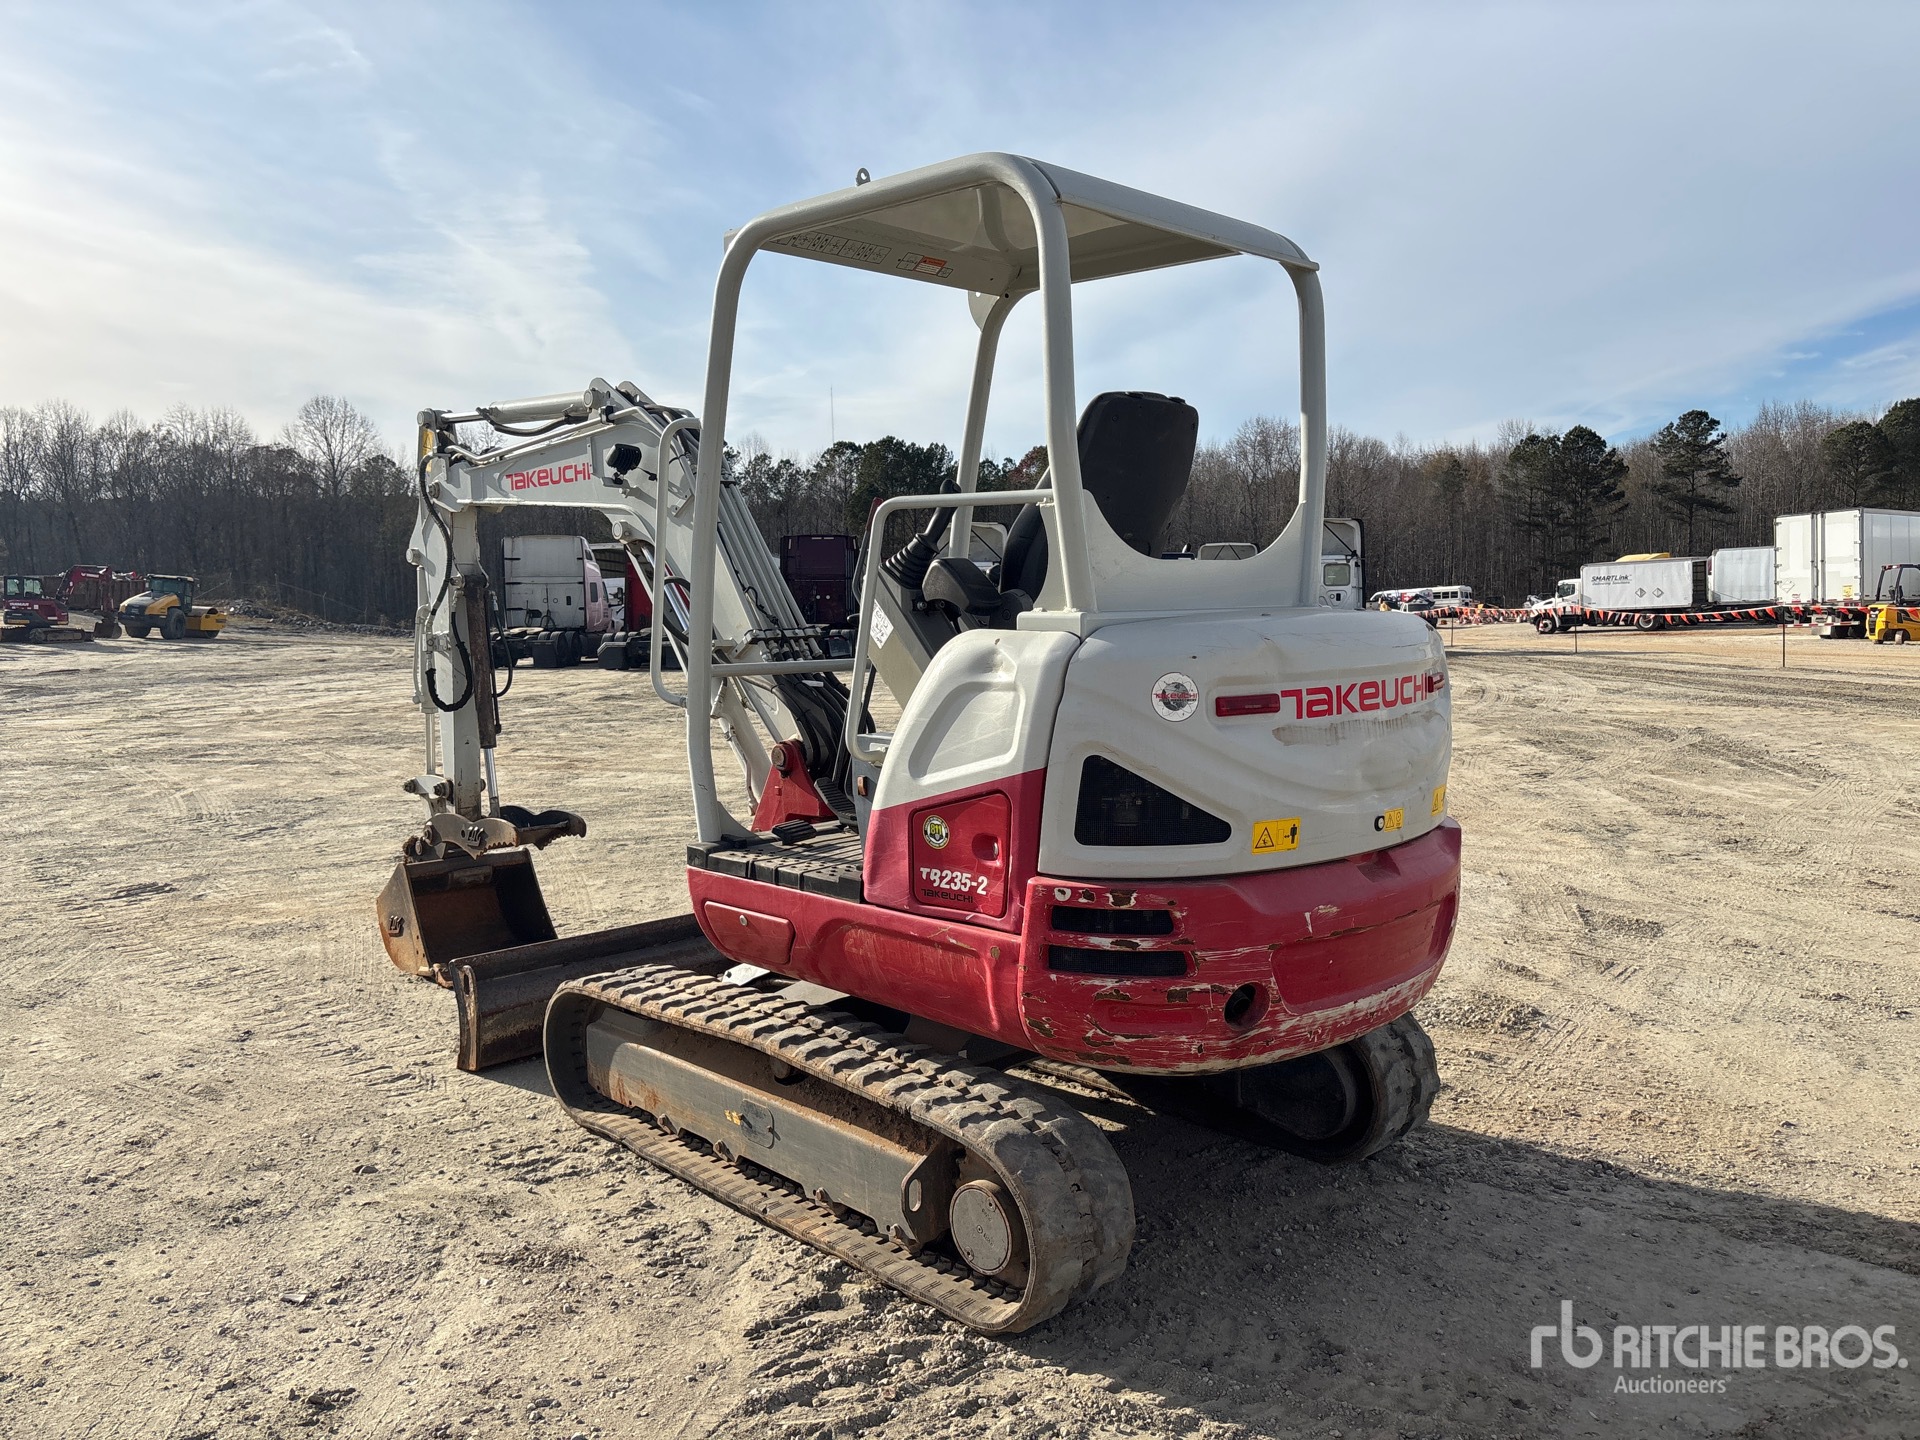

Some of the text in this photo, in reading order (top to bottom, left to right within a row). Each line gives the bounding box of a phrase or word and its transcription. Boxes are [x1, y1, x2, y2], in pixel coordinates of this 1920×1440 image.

[505, 462, 591, 491] TAKEUCHI
[1280, 672, 1428, 720] TAKEUCHI
[920, 867, 988, 895] TB235-2
[921, 888, 974, 903] TAKEUCHI
